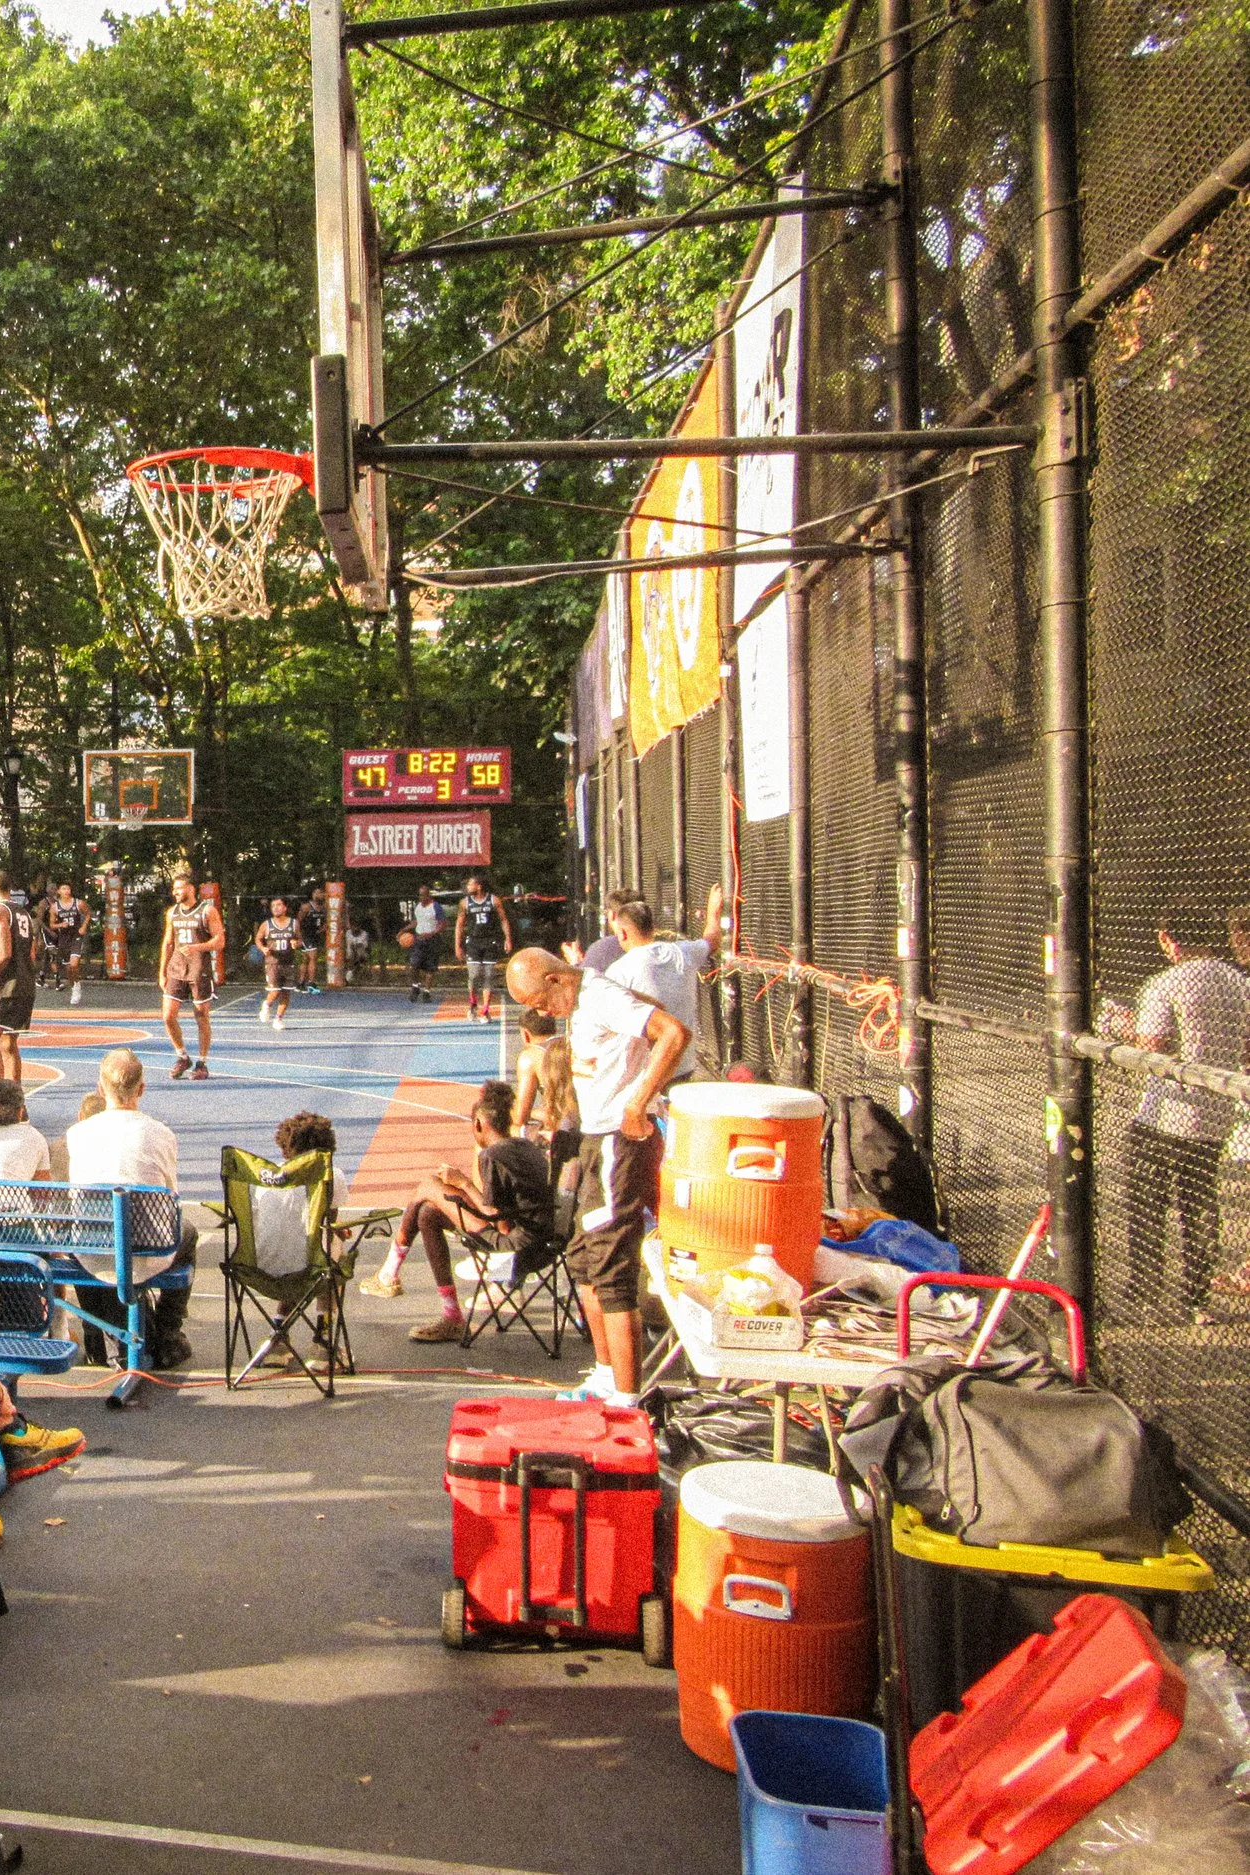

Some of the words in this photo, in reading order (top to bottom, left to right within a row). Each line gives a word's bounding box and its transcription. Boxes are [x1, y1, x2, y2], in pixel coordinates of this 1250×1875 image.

[349, 755, 388, 765] GUEST
[409, 752, 456, 773] 8:22
[466, 753, 501, 762] HOME
[357, 767, 387, 788] 47
[473, 765, 500, 786] 58
[398, 786, 434, 794] PERIOD
[436, 779, 450, 799] 3
[368, 824, 419, 855] STREET
[423, 823, 482, 854] BURGER
[476, 913, 487, 924] 15
[178, 928, 193, 944] 21
[276, 939, 287, 950] 10
[733, 1319, 783, 1331] RECOVER
